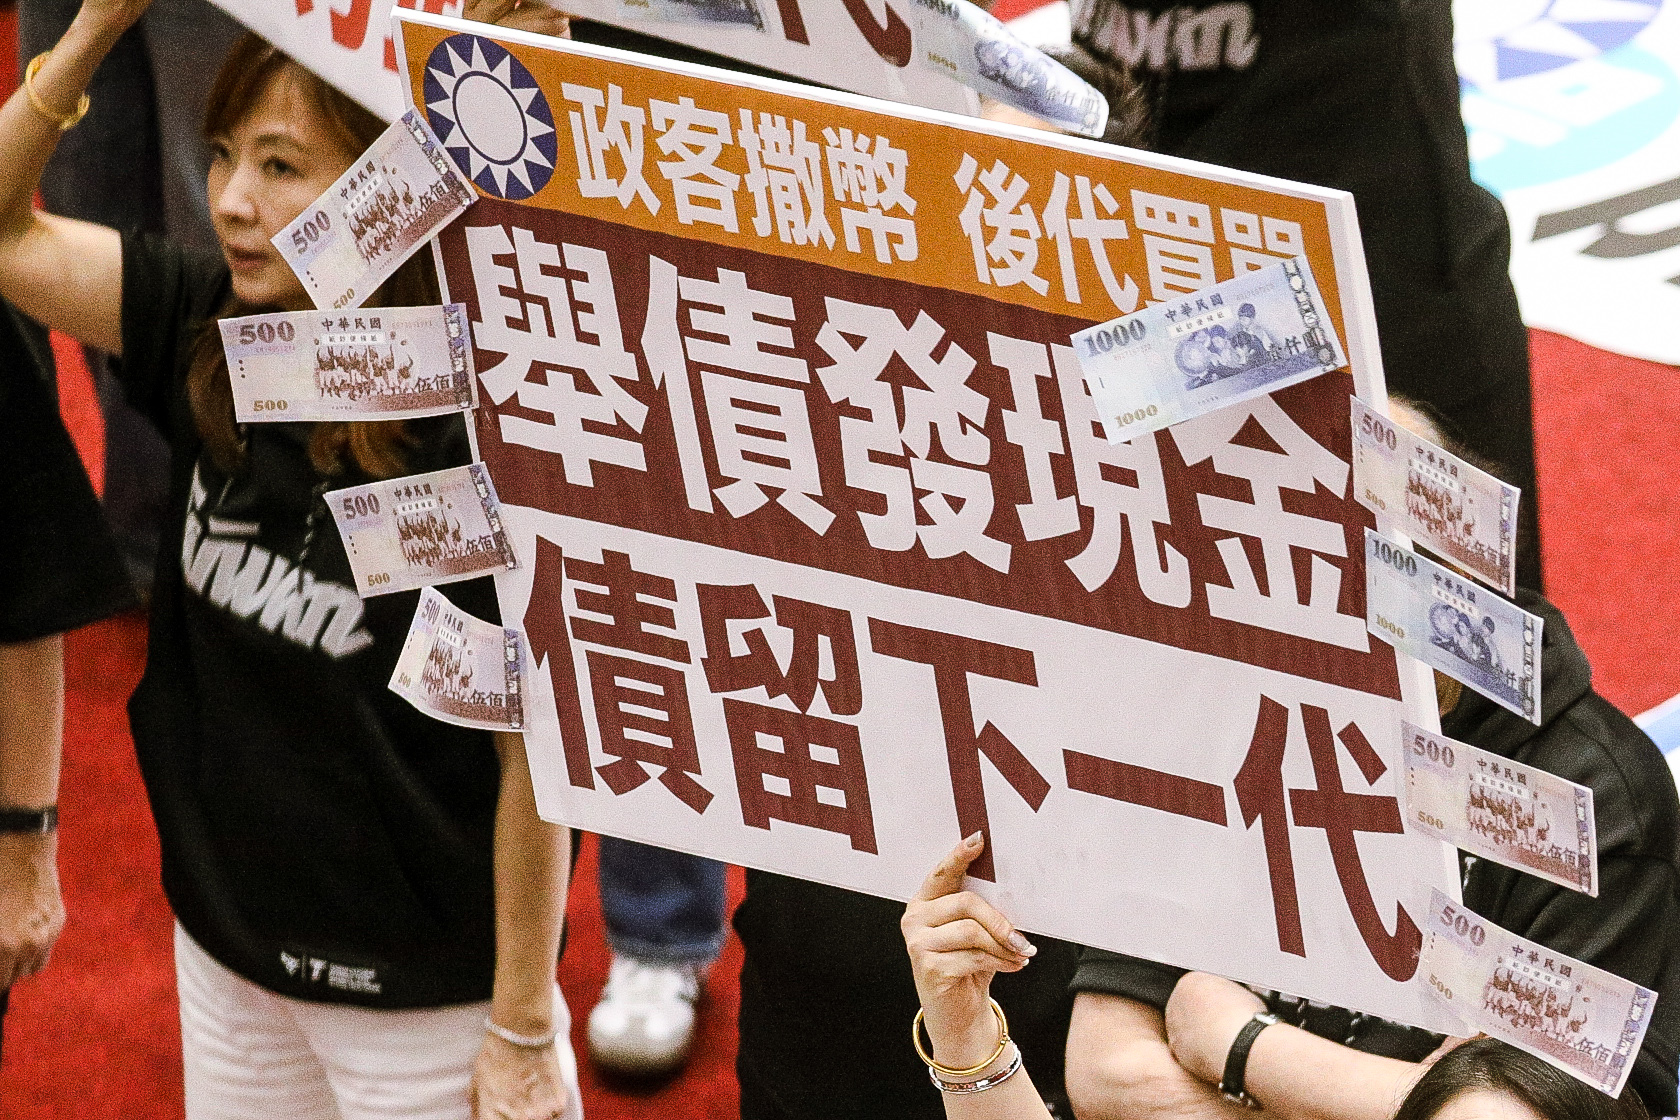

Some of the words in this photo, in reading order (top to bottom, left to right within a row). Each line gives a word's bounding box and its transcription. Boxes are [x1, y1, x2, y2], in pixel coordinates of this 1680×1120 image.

[561, 82, 919, 265] 政客撒幣
[291, 210, 331, 255] 500
[320, 316, 383, 331] 中華民國
[1163, 292, 1224, 323] 中華民國
[239, 320, 296, 345] 500
[1083, 318, 1147, 358] 1000
[253, 399, 289, 412] 500
[1113, 403, 1159, 430] 1000
[468, 222, 1369, 655] 舉債發現金
[1361, 412, 1398, 451] 500
[342, 492, 382, 521] 500
[1372, 538, 1418, 578] 1000
[367, 572, 391, 588] 500
[523, 536, 1422, 982] 債留下一代
[1413, 734, 1456, 770] 500
[1417, 809, 1445, 831] 500
[1440, 904, 1487, 948] 500
[1428, 972, 1455, 1001] 500
